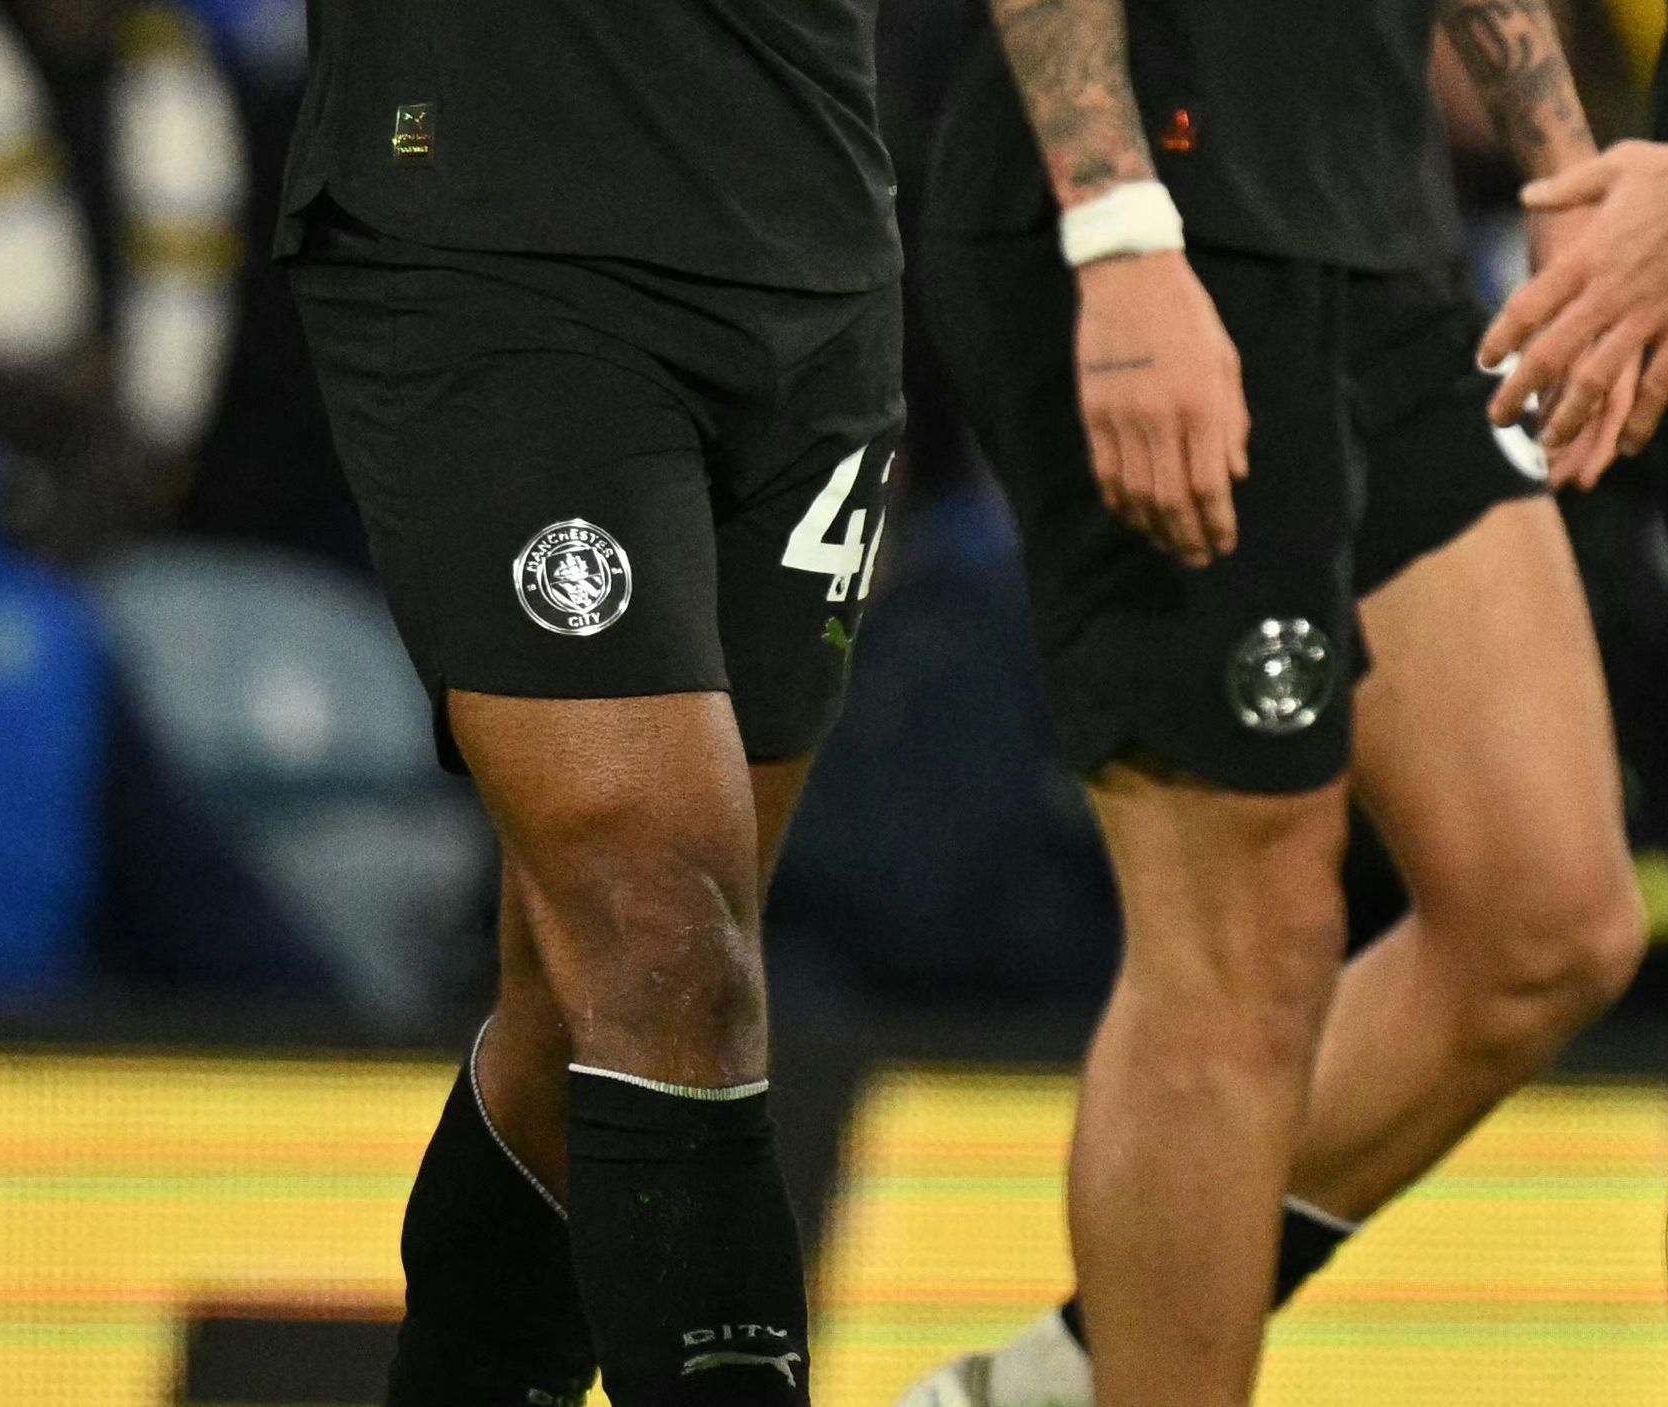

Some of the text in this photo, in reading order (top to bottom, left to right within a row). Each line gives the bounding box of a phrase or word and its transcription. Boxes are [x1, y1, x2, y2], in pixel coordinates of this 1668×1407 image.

[781, 446, 896, 602] 4
[525, 528, 615, 573] MANCHESTER
[568, 612, 600, 628] CITY
